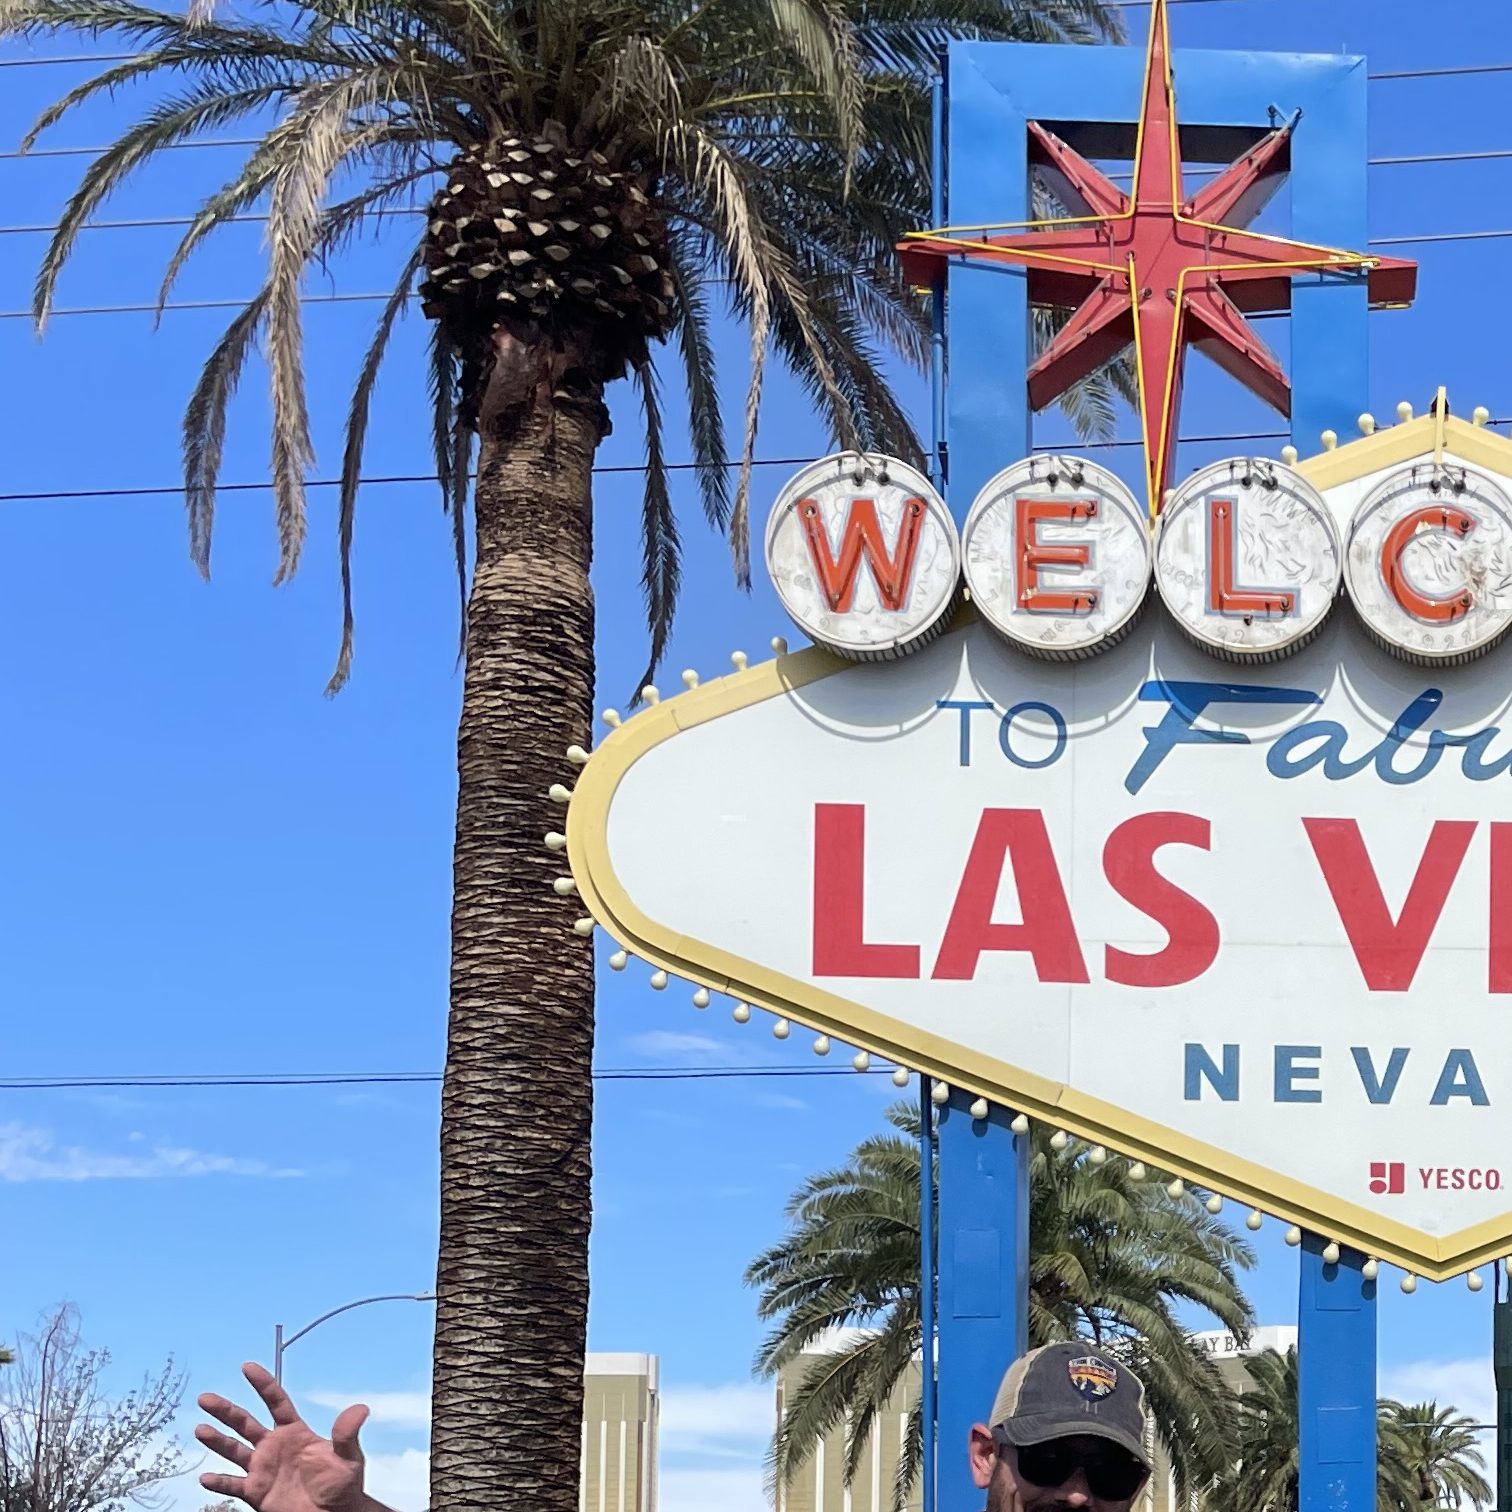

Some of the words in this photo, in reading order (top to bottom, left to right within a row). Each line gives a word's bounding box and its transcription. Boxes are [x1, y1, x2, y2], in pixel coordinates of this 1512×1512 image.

[937, 700, 1068, 769] TO
[812, 803, 1220, 988] LAS
[1418, 1168, 1501, 1191] YESCO
